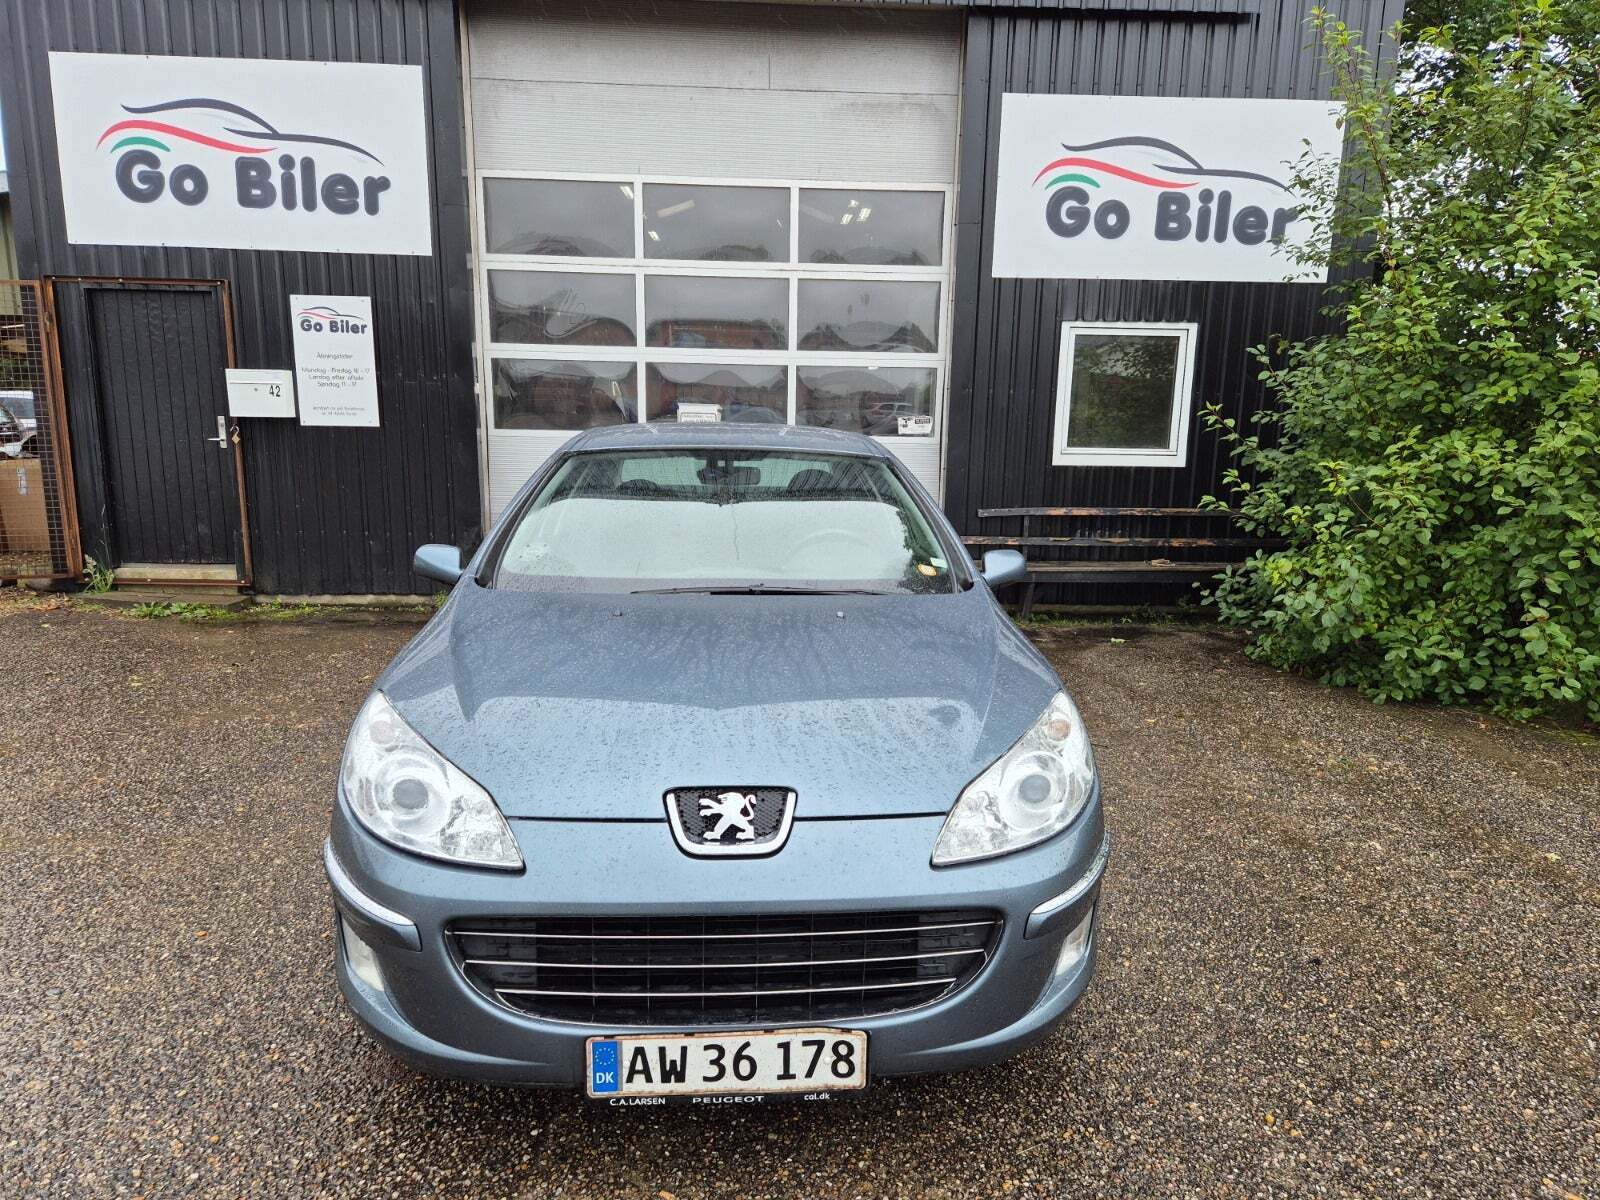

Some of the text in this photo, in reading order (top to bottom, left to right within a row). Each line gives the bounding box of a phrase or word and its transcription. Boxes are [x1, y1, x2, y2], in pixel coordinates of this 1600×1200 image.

[116, 149, 391, 216] Go Biler
[1046, 186, 1299, 246] Go Biler
[301, 319, 367, 334] Go Biler
[269, 385, 281, 397] 42
[625, 1039, 856, 1084] AW 36 178
[596, 1072, 614, 1084] DK
[692, 1096, 765, 1104] PEUGEOT
[804, 1093, 830, 1101] cal.dk
